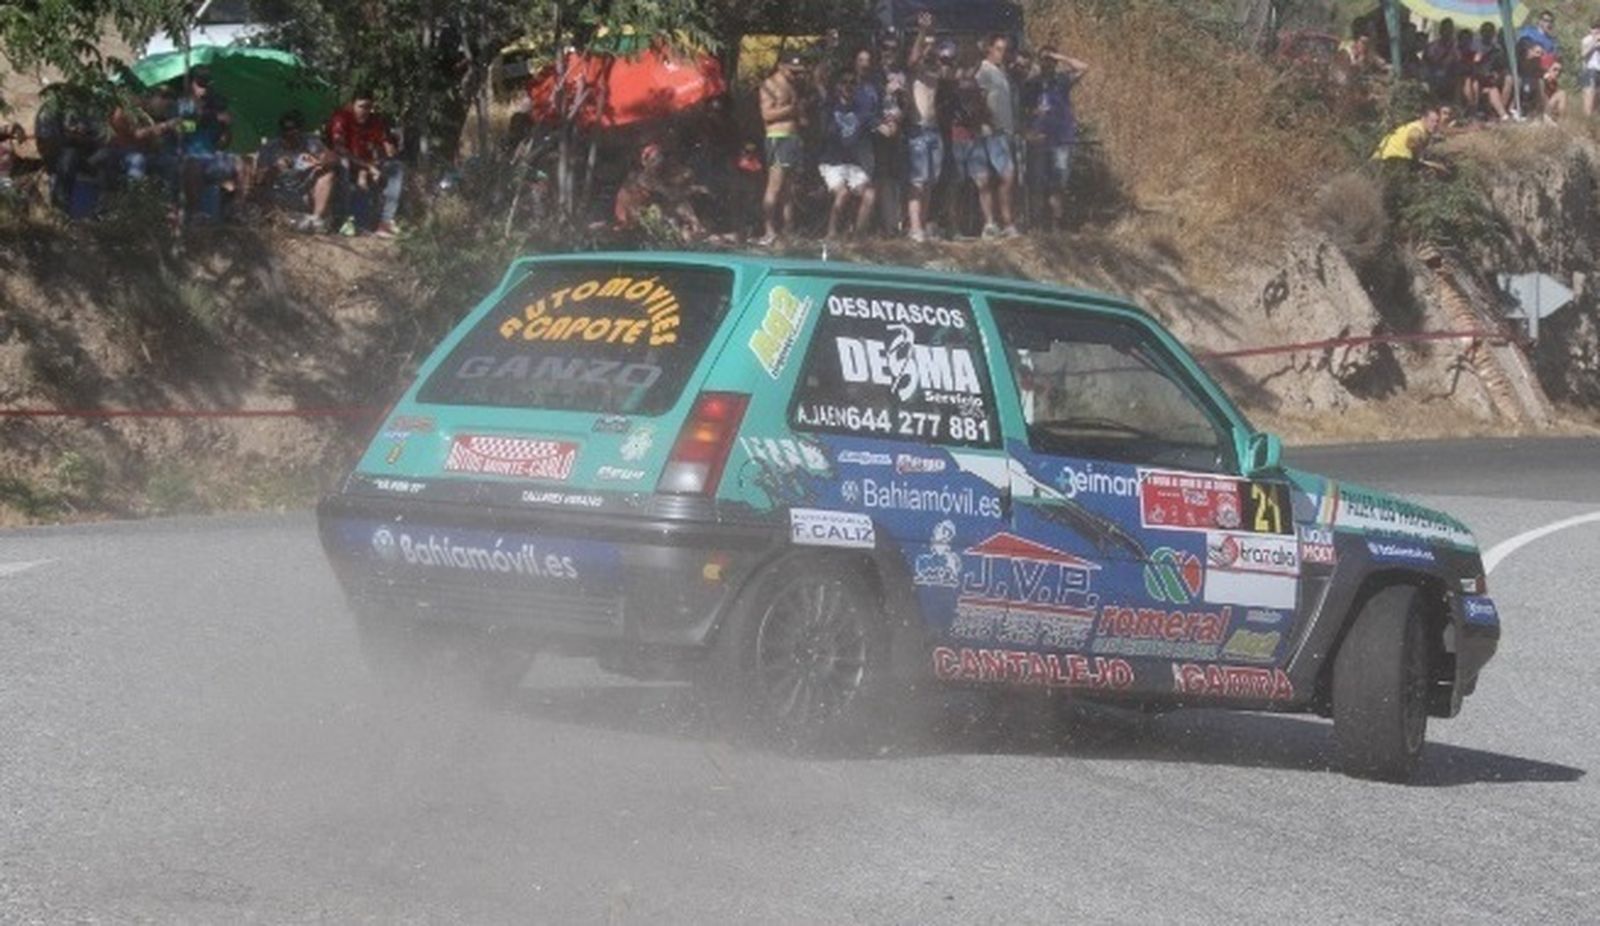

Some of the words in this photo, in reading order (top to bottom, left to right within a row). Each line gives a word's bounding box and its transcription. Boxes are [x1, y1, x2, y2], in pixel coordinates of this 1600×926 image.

[523, 316, 649, 344] CAPOTE
[827, 295, 964, 328] DESATASCOS
[456, 356, 663, 387] GANZO
[847, 407, 892, 433] 644
[898, 411, 940, 437] 277
[949, 415, 990, 442] 881
[863, 478, 1002, 519] Bahiamóvil.es
[1252, 482, 1282, 534] 21
[400, 533, 578, 578] Bahiamóvil.es
[1303, 544, 1335, 562] MOLY
[1097, 605, 1233, 645] romeral
[933, 647, 1134, 687] CANTALEJO
